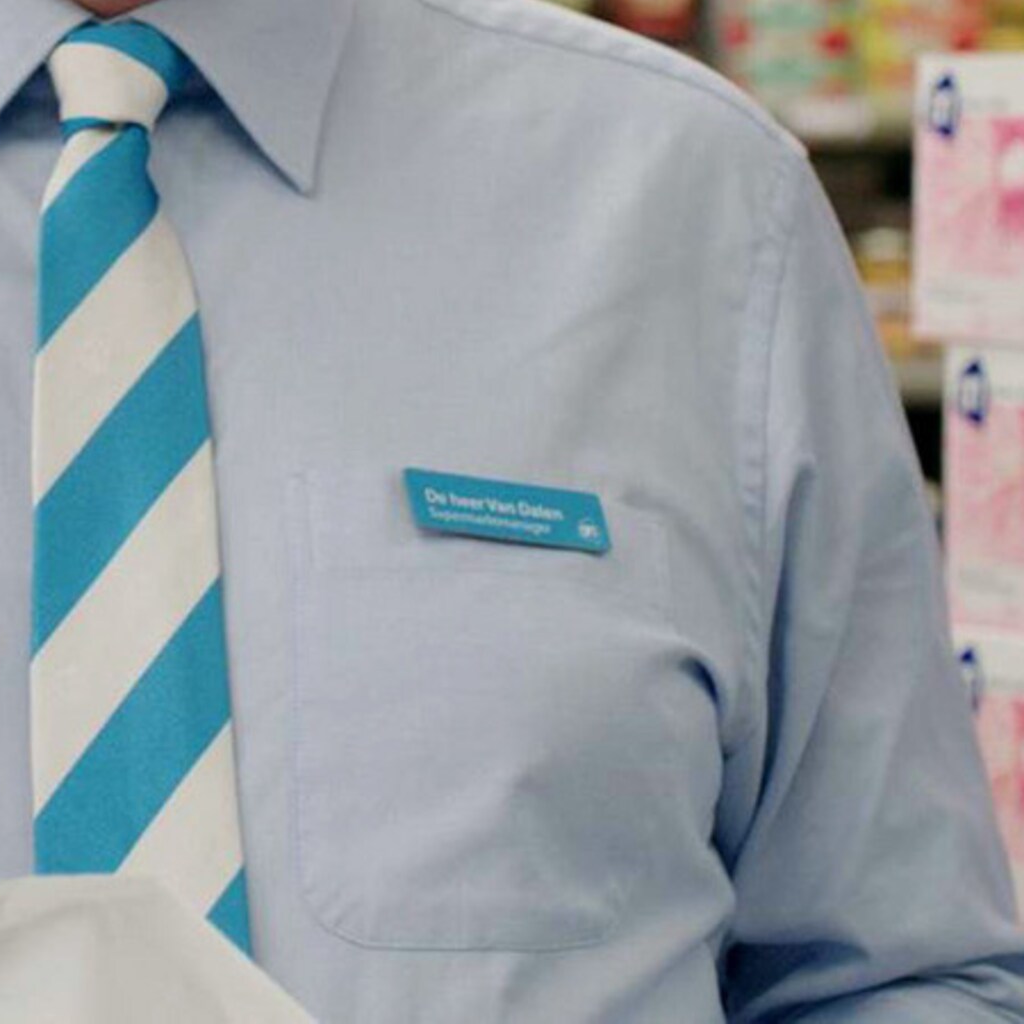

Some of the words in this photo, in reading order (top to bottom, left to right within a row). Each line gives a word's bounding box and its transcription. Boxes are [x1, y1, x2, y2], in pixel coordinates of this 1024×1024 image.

[424, 487, 447, 505] De
[449, 493, 484, 512] heer
[484, 497, 516, 516] Van
[518, 501, 565, 521] Dalen
